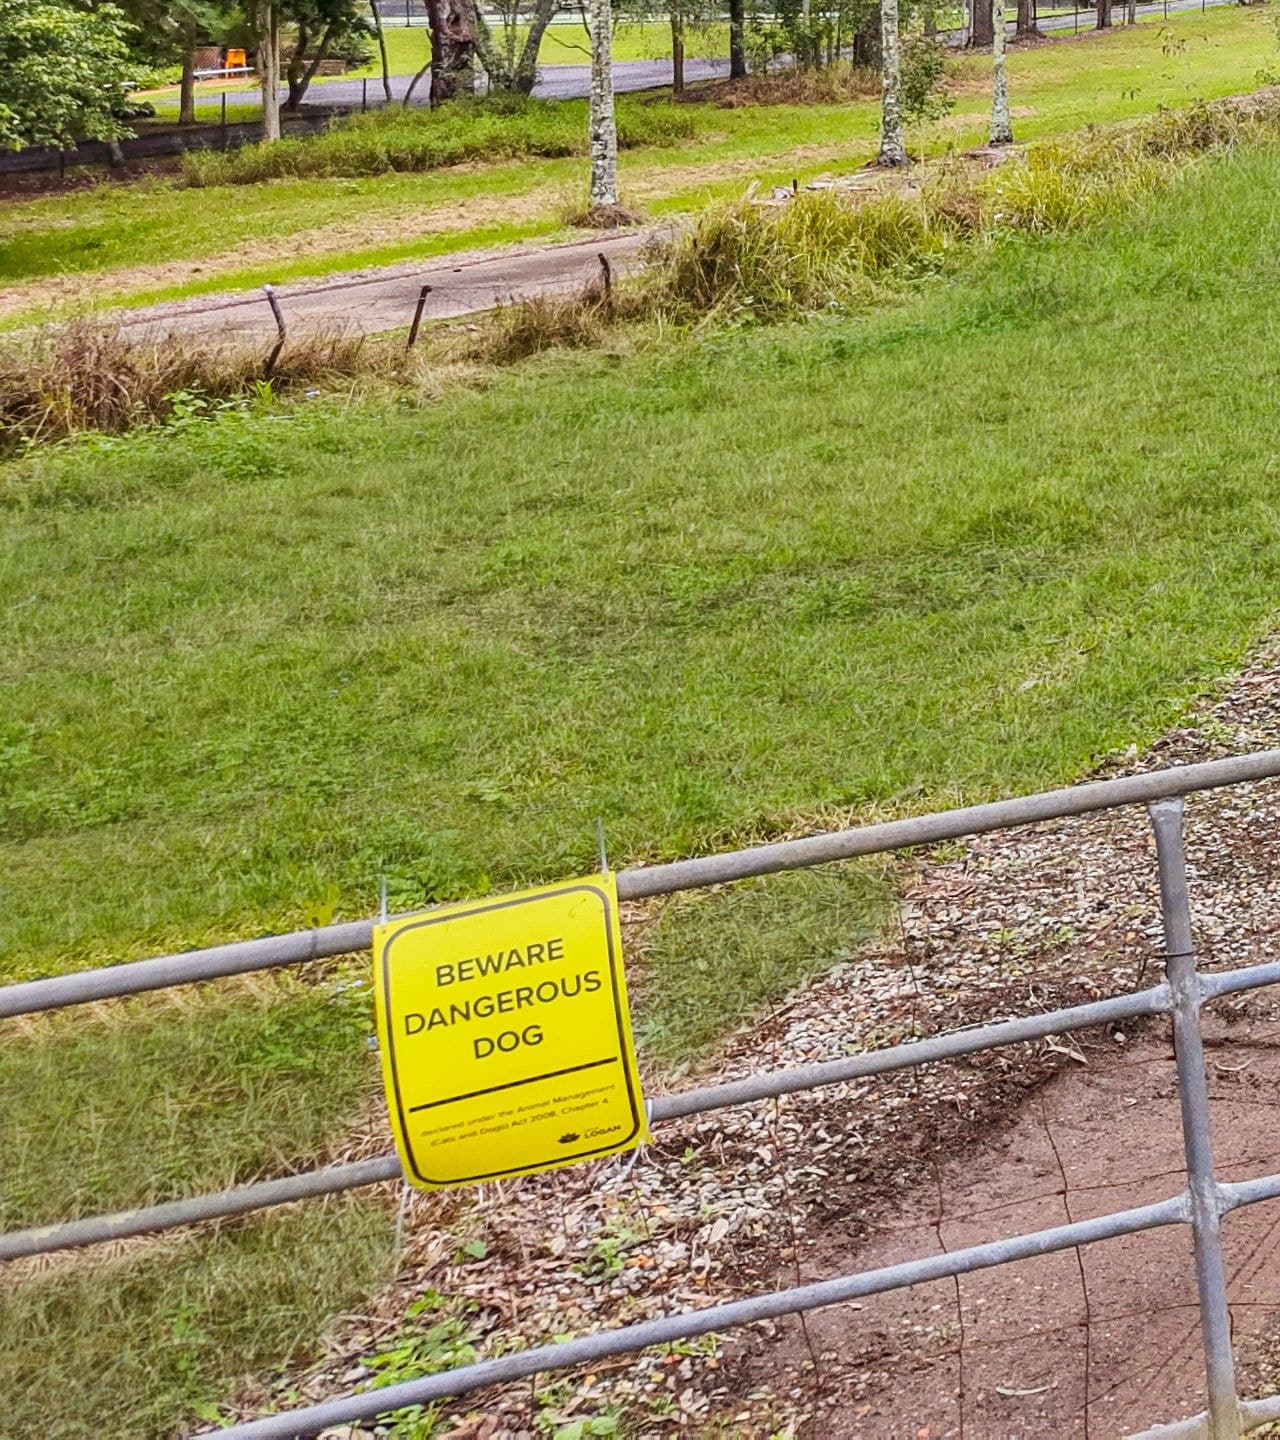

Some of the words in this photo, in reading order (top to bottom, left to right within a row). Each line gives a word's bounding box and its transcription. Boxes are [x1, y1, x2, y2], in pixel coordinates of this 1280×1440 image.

[436, 938, 564, 987] BEWARE
[404, 970, 602, 1035] DANGEROUS
[473, 1024, 544, 1059] DOG
[584, 1125, 622, 1139] LOGAN
